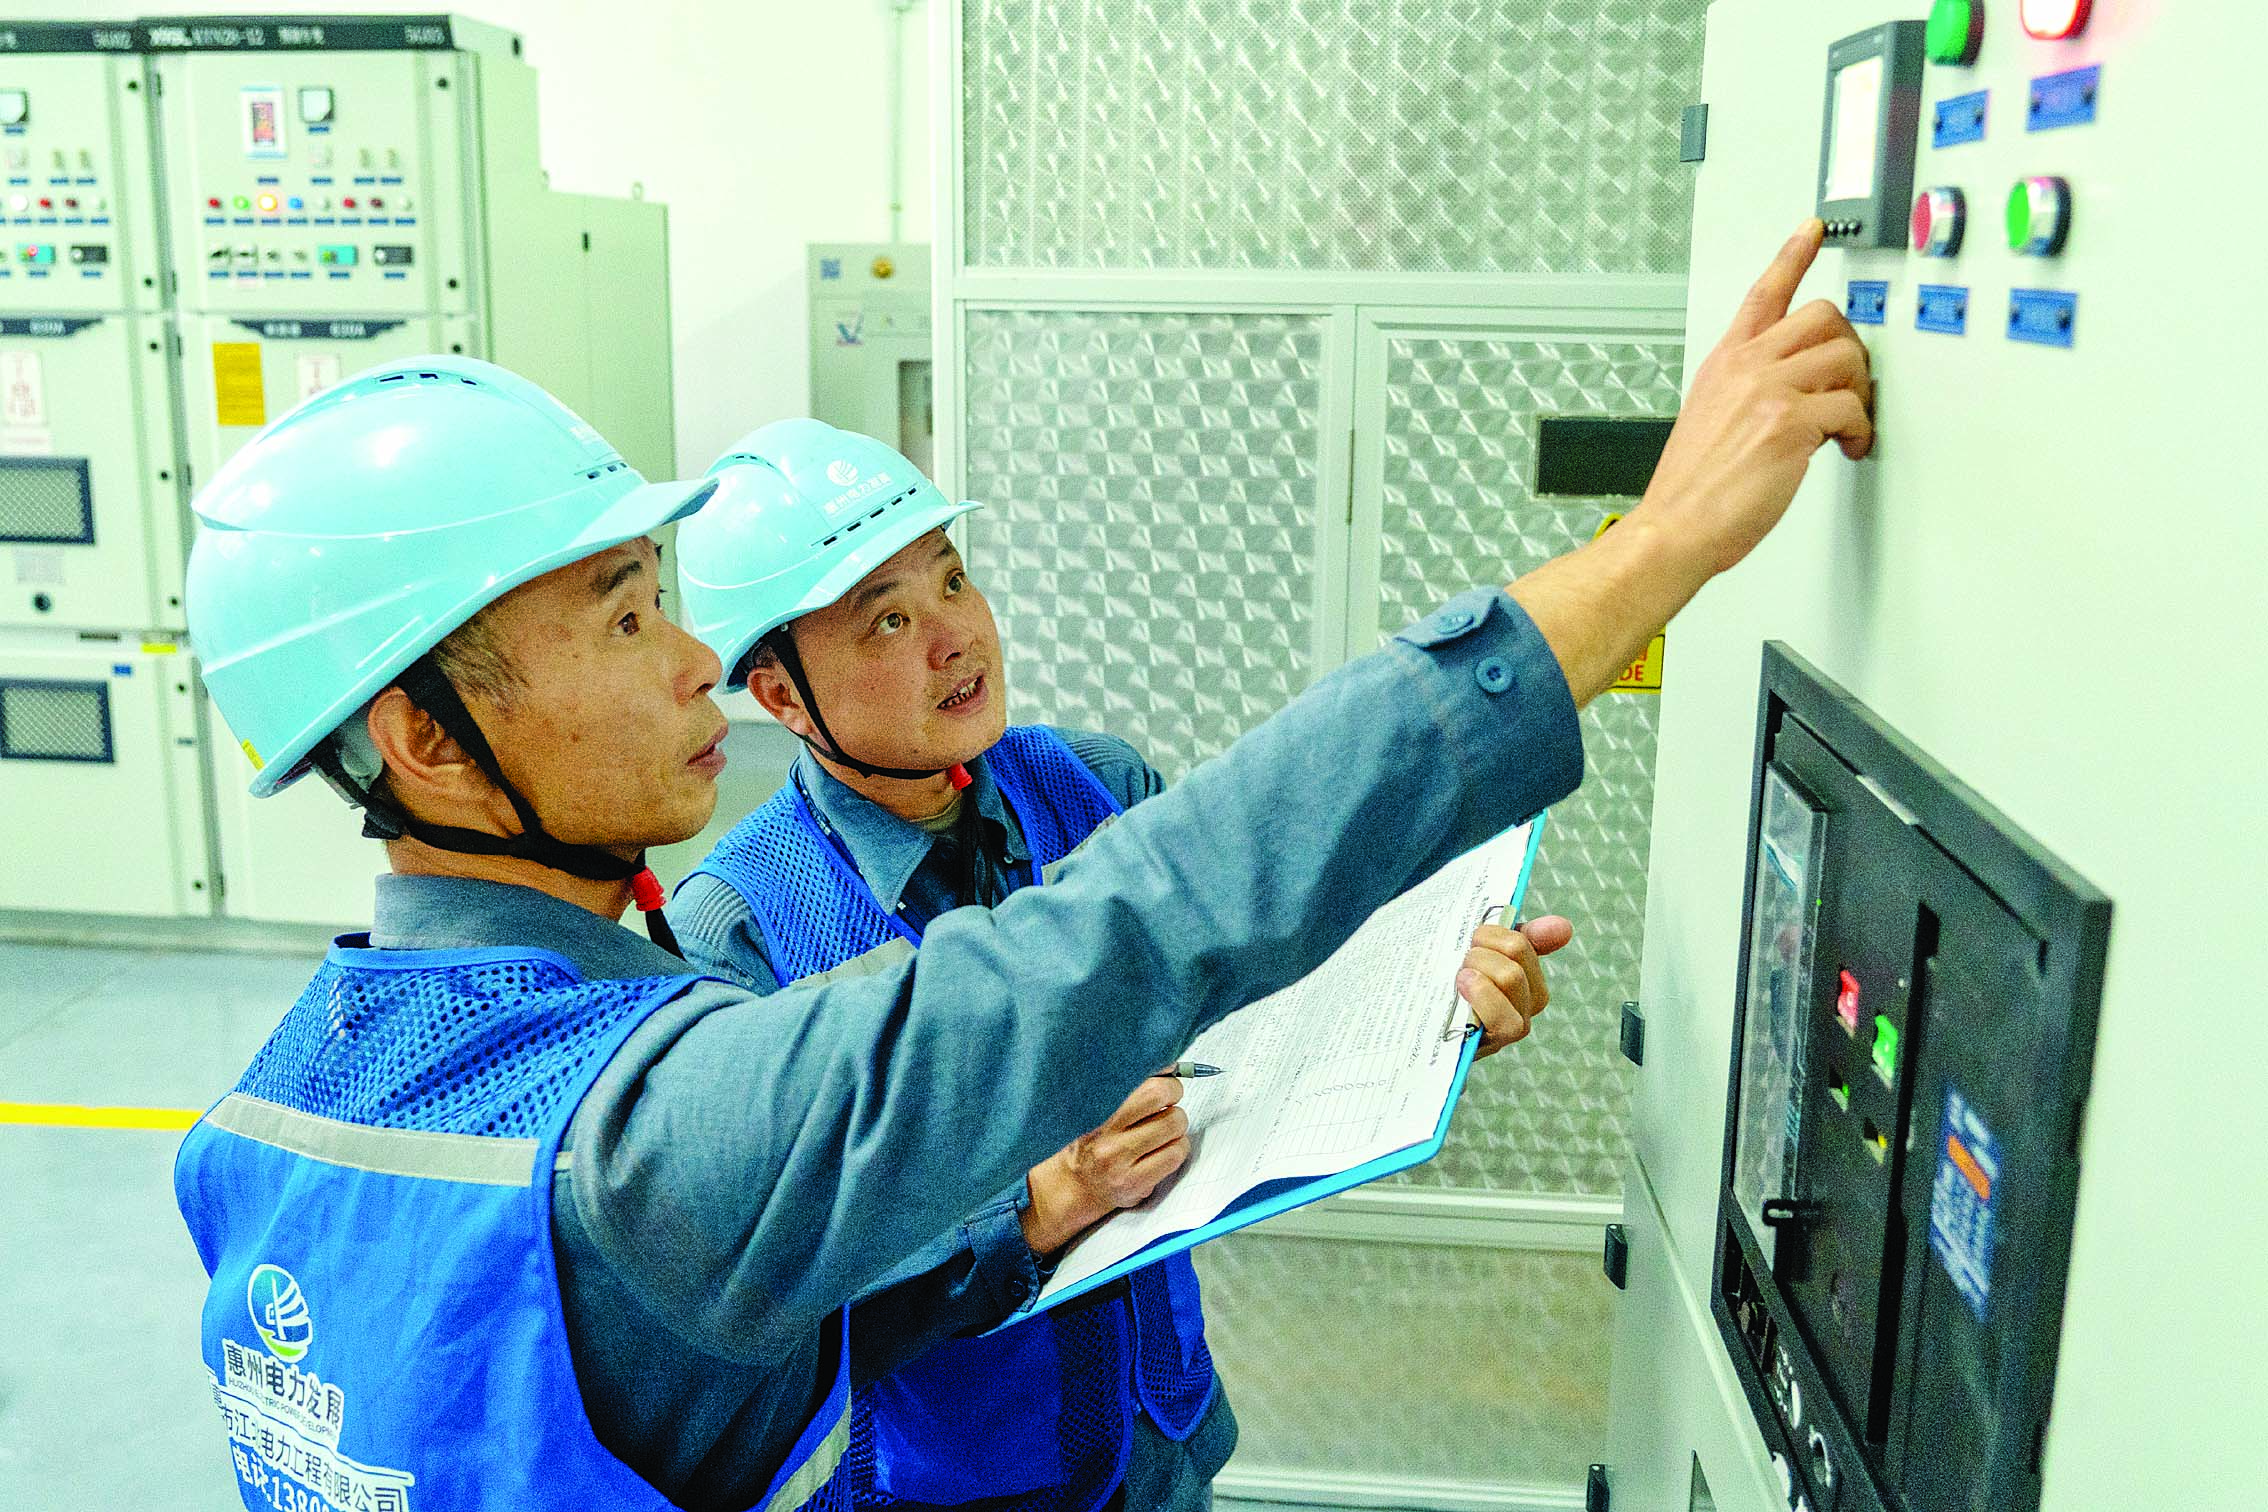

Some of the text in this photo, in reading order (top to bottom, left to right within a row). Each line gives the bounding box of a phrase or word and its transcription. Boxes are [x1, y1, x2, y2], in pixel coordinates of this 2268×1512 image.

[226, 1344, 341, 1430] 惠州电力发展
